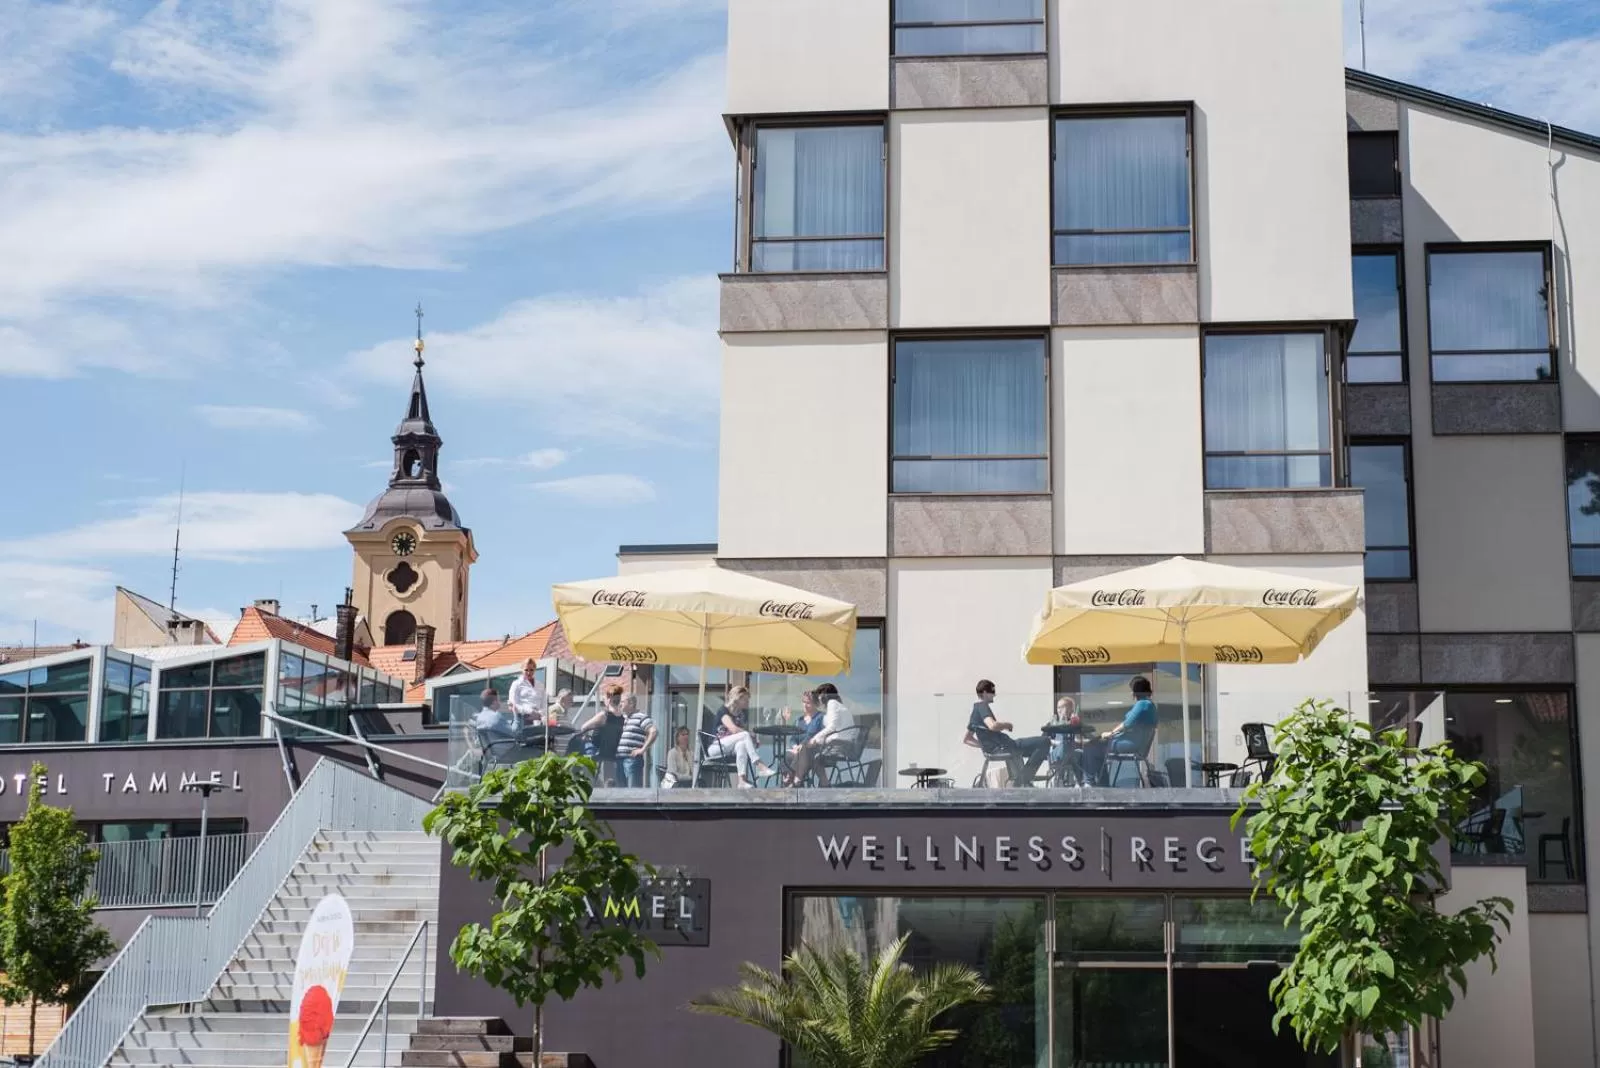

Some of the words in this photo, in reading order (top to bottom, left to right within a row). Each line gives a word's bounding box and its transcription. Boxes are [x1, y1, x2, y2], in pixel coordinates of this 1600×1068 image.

[0, 773, 67, 795] TEL
[102, 770, 241, 792] TAMMEL
[816, 835, 1078, 862] WELLNESS
[1130, 836, 1257, 863] RECE
